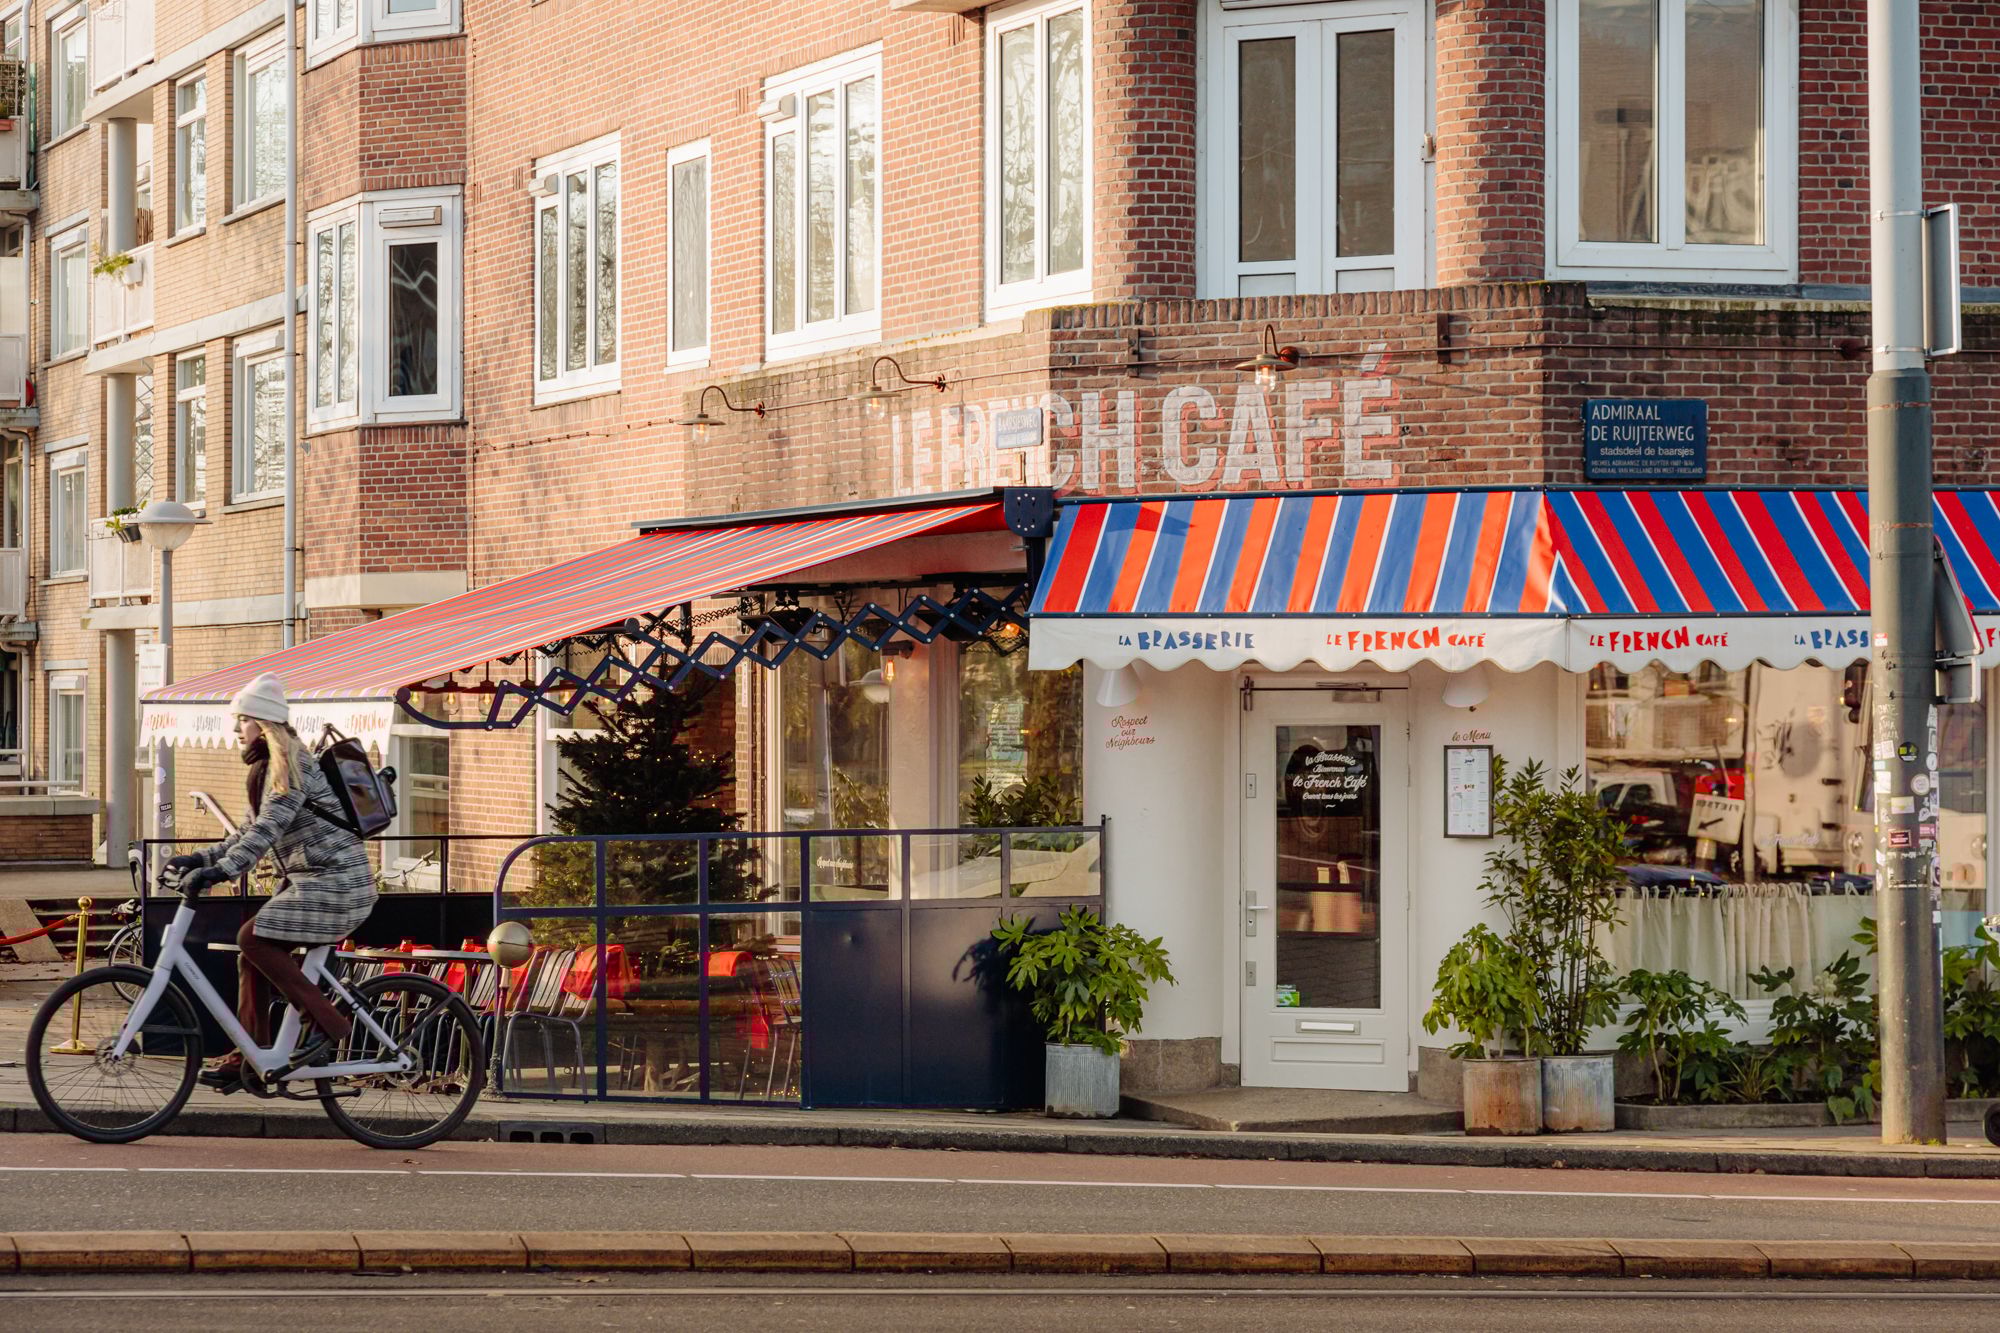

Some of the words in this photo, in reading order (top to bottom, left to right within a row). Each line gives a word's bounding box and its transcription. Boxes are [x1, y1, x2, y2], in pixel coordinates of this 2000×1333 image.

[1592, 404, 1662, 421] ADMIRAAL
[891, 408, 933, 497] LE
[1162, 353, 1398, 491] CAFÉ
[1591, 425, 1608, 441] DE
[1612, 425, 1695, 446] RUIJTERWEG
[1599, 446, 1642, 456] stadsdeel
[1644, 446, 1656, 456] de
[1657, 446, 1695, 458] baarsjes
[1118, 635, 1132, 646] LA
[1137, 629, 1256, 650] BRASSERIE
[1326, 634, 1343, 646] LE
[1347, 626, 1440, 652] FRENCH
[1447, 632, 1487, 648] CAFÉ
[1589, 634, 1605, 647] LE
[1608, 625, 1690, 653] FRENCH
[1695, 631, 1729, 647] CAFÉ
[1794, 634, 1806, 645] LA
[1810, 628, 1869, 649] BRASS
[1111, 715, 1148, 728] Respect
[1121, 728, 1136, 736] our
[1452, 731, 1461, 742] le
[1463, 729, 1492, 743] Menu
[1105, 735, 1156, 750] Neighbours
[1305, 755, 1314, 766] la
[1313, 750, 1356, 766] Brasserie
[1292, 775, 1304, 787] le
[1303, 774, 1342, 789] French
[1343, 774, 1369, 792] Café
